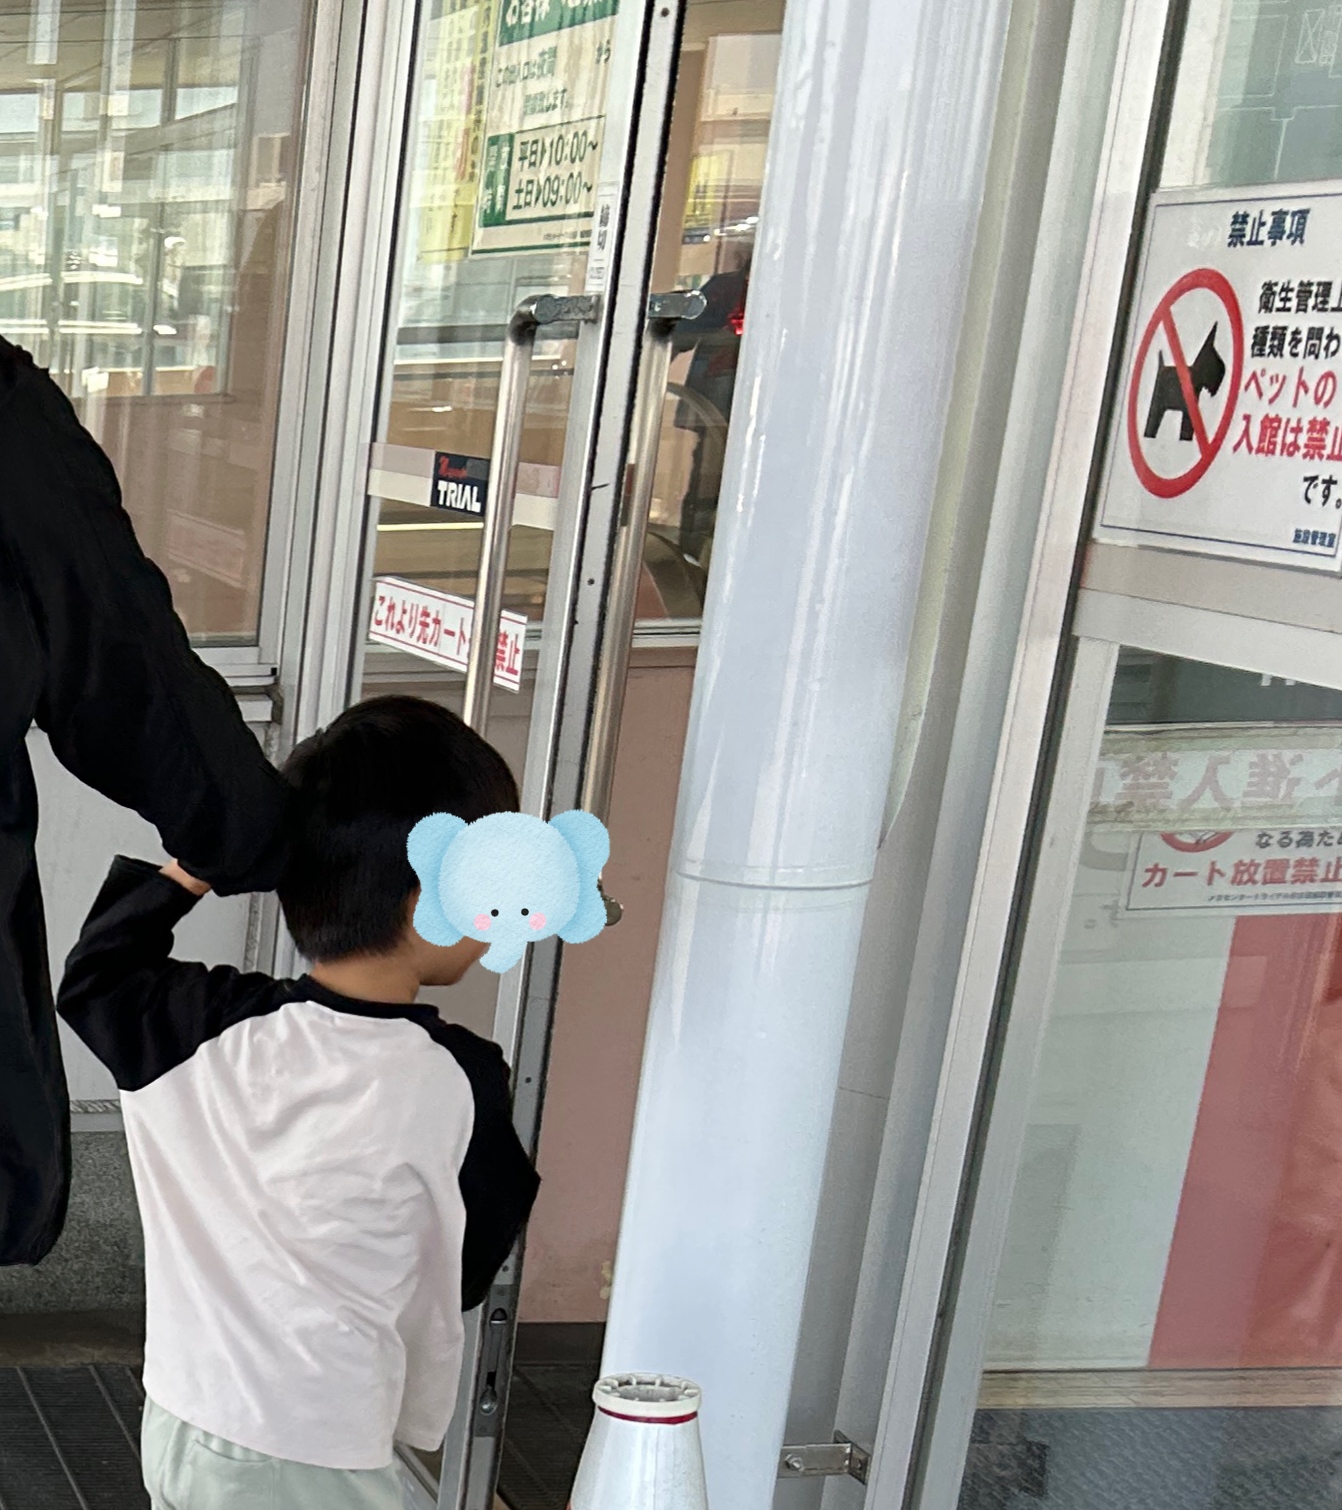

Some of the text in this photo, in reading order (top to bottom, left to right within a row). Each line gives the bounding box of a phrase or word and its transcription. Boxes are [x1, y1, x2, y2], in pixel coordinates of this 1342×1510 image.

[1226, 208, 1311, 248] 禁止事項
[1250, 324, 1341, 360] 種類を問わ
[1243, 365, 1338, 409] ペットの
[437, 479, 482, 513] TRIAL
